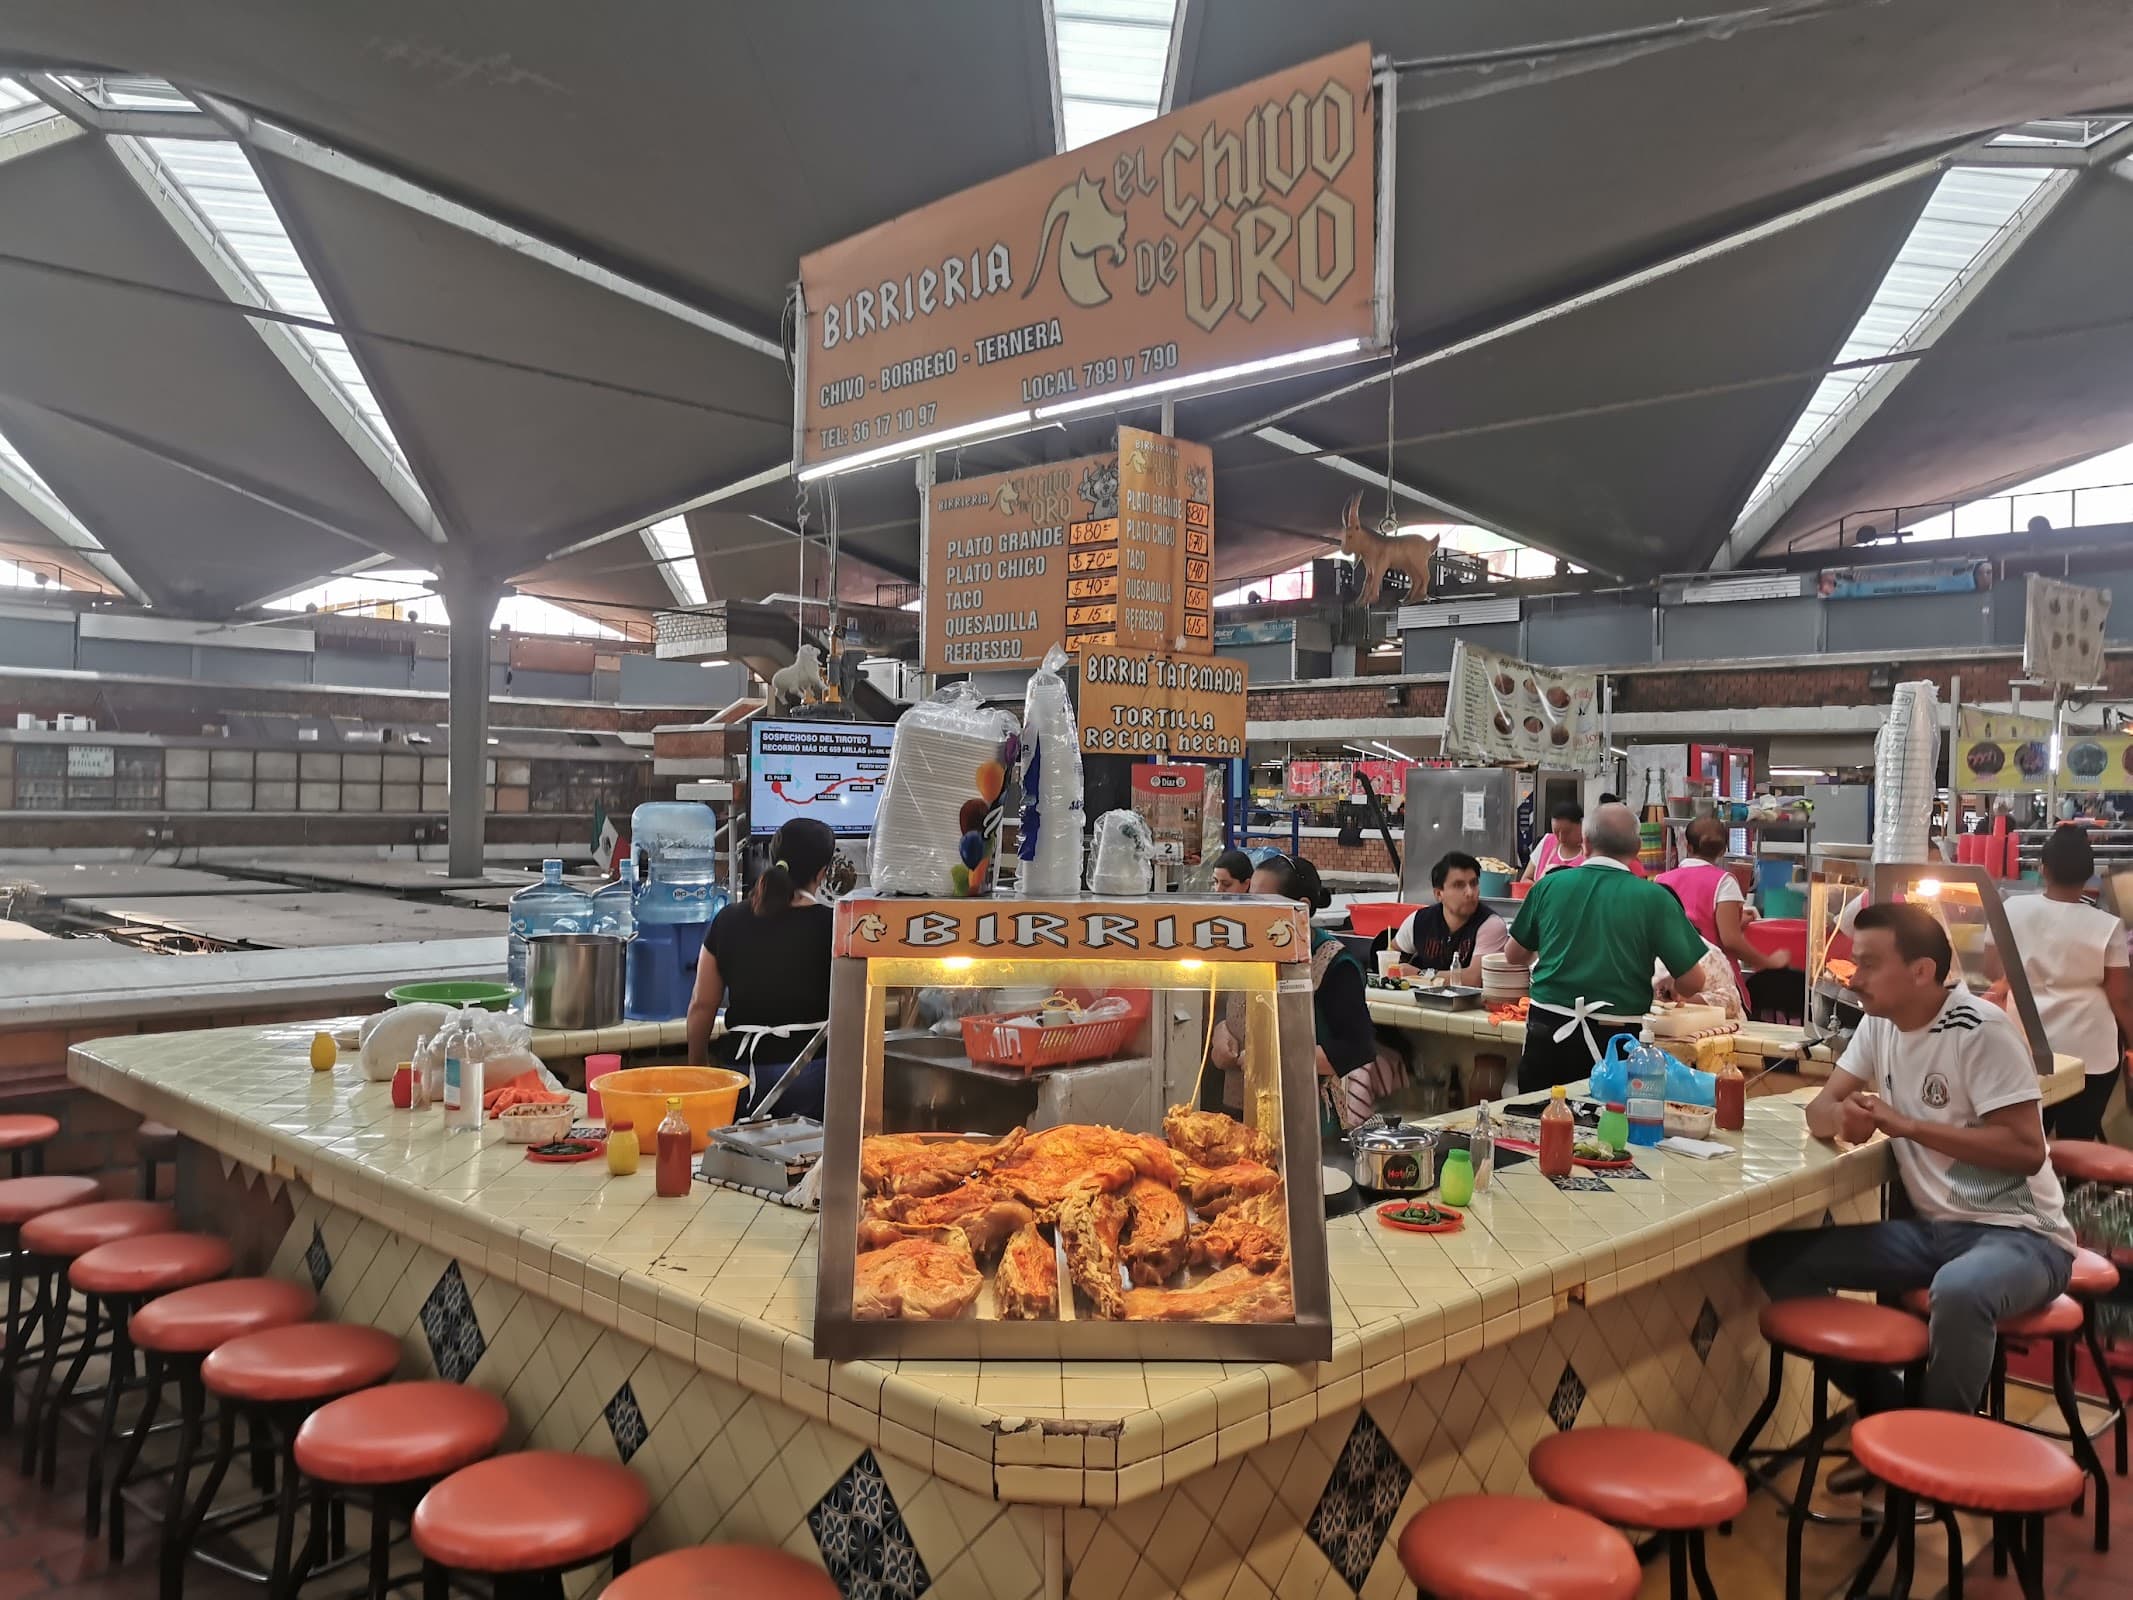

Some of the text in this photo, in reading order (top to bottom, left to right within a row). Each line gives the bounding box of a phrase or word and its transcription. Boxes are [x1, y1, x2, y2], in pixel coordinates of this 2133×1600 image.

[1183, 187, 1355, 333] ORO
[820, 375, 865, 408] CHIVO
[881, 349, 957, 391] BORREGO
[975, 318, 1063, 365] TERNERA
[1021, 362, 1078, 403] LOCAL
[1082, 358, 1119, 392] 789
[1140, 343, 1179, 376] 790
[820, 403, 937, 449] TEL: 36 17 10 97
[1032, 496, 1072, 525] ORO
[1127, 489, 1182, 519] PLATO GRANDE
[947, 526, 1063, 559] PLATO GRANDE
[1127, 519, 1175, 546] PLATO CHICO
[946, 555, 1046, 585] PLATO CHICO
[1127, 549, 1146, 571] TACO
[946, 590, 982, 611] TACO
[1126, 578, 1171, 605] QUESADILLA
[946, 610, 1038, 638] QUESADILLA
[1125, 607, 1164, 632] REFRESCO
[945, 639, 1022, 662] REFRESCO
[1086, 653, 1148, 686] BIRRIA
[1111, 705, 1215, 731] TORTILLA
[762, 732, 868, 744] SOSPECHOSO DEL TIROTEO
[842, 746, 867, 754] MILLAS
[898, 911, 1254, 951] BIRRIA
